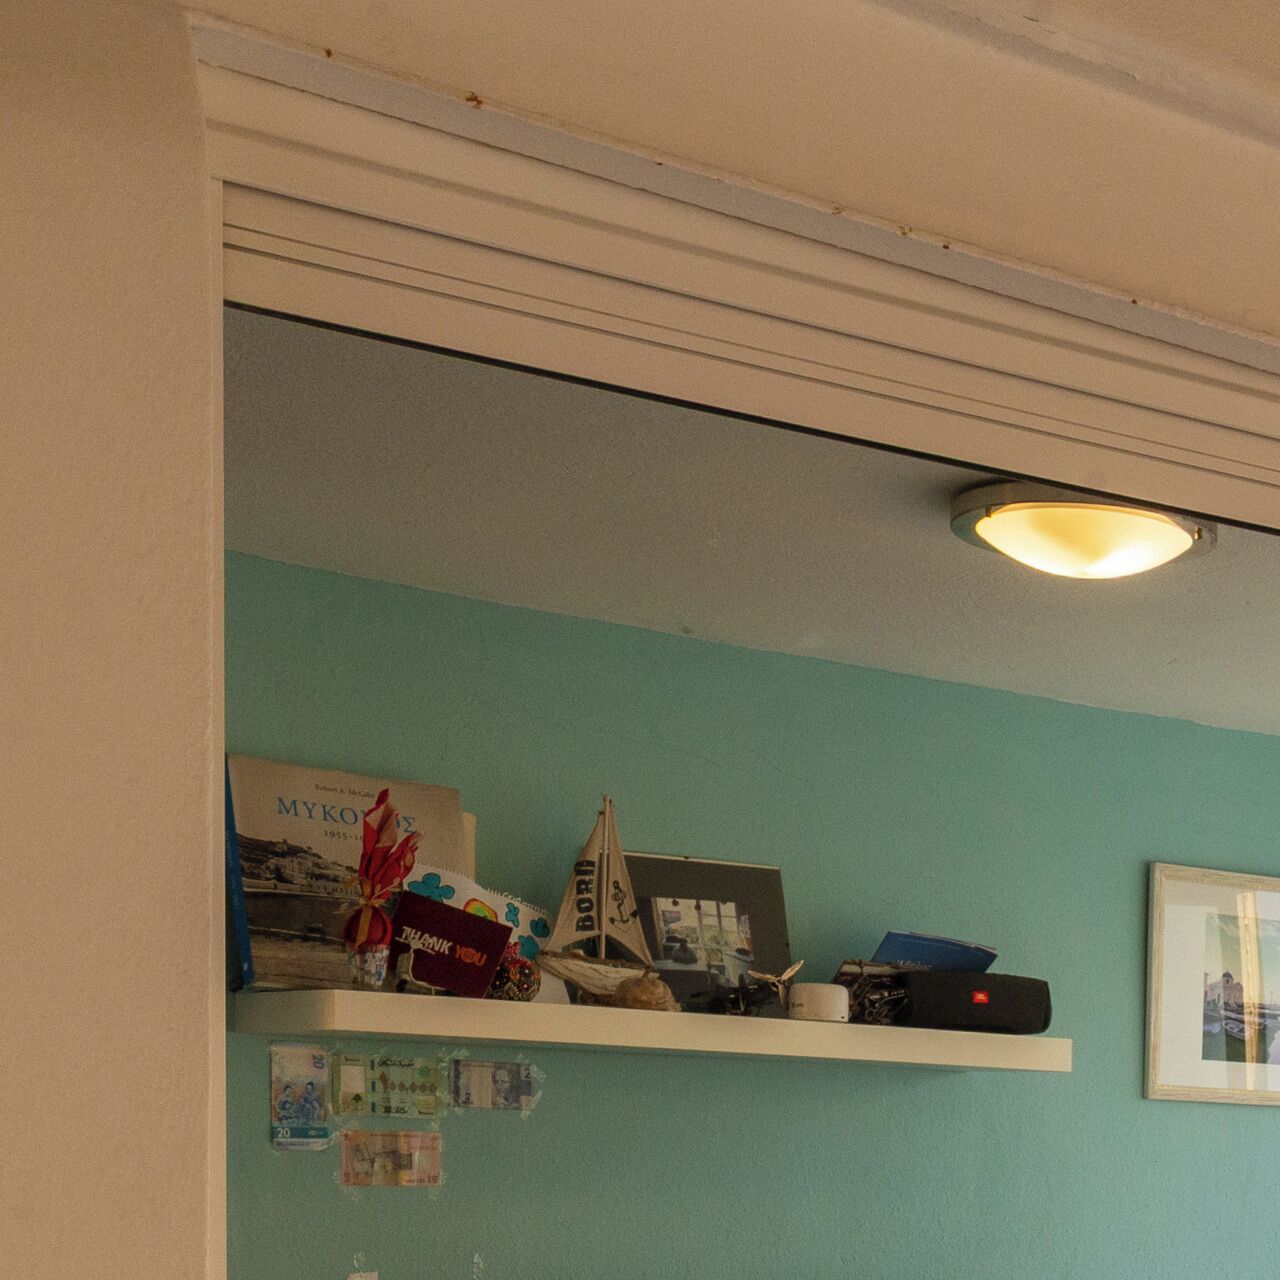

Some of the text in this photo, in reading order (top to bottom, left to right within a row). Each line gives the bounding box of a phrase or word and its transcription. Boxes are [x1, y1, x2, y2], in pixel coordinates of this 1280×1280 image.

[574, 860, 595, 932] BORN
[455, 944, 487, 966] YOU
[277, 1127, 291, 1138] 20
